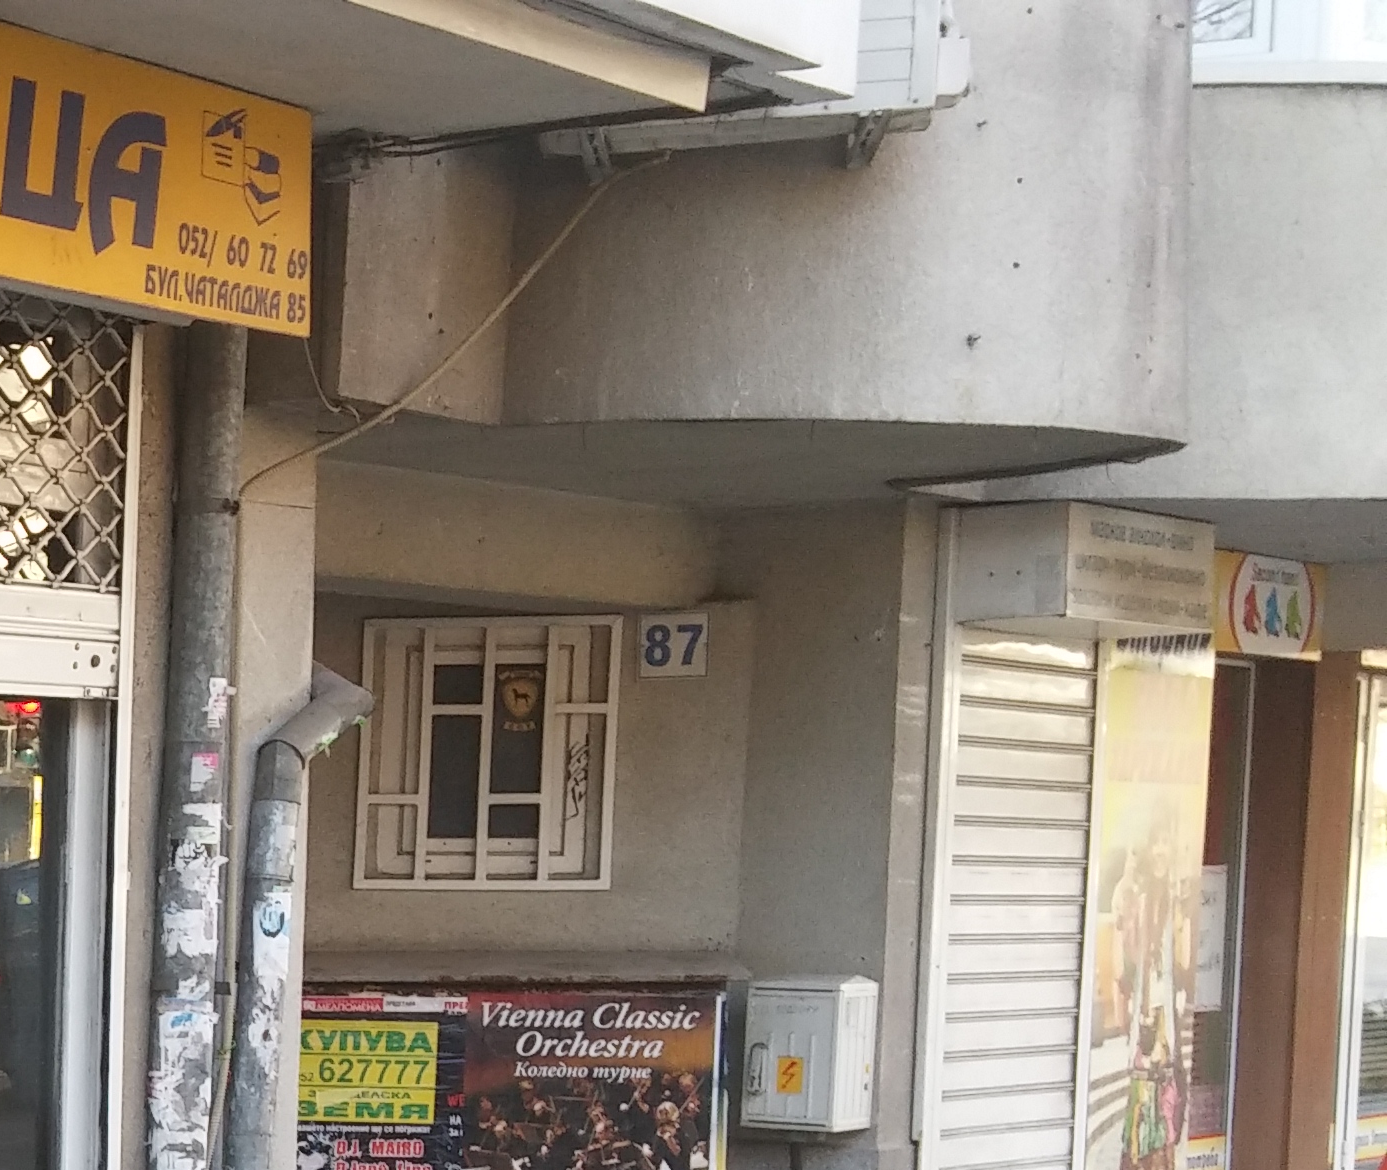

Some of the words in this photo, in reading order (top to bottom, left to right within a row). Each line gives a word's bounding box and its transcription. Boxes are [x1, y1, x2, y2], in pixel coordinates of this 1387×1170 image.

[179, 222, 218, 268] 052/
[227, 234, 250, 269] 60
[260, 241, 277, 275] 72
[287, 248, 308, 280] 69
[144, 263, 281, 320] БУЛ.ЧАТАЛДЖА
[287, 292, 306, 324] 85
[645, 624, 703, 667] 87
[480, 1002, 583, 1029] Vienna
[592, 1002, 700, 1031] Classic
[515, 1030, 664, 1058] Orchestra
[318, 1058, 430, 1084] 627777
[514, 1061, 588, 1079] Коледно
[592, 1066, 652, 1084] турне
[299, 1099, 429, 1120] ЗЕМЯ
